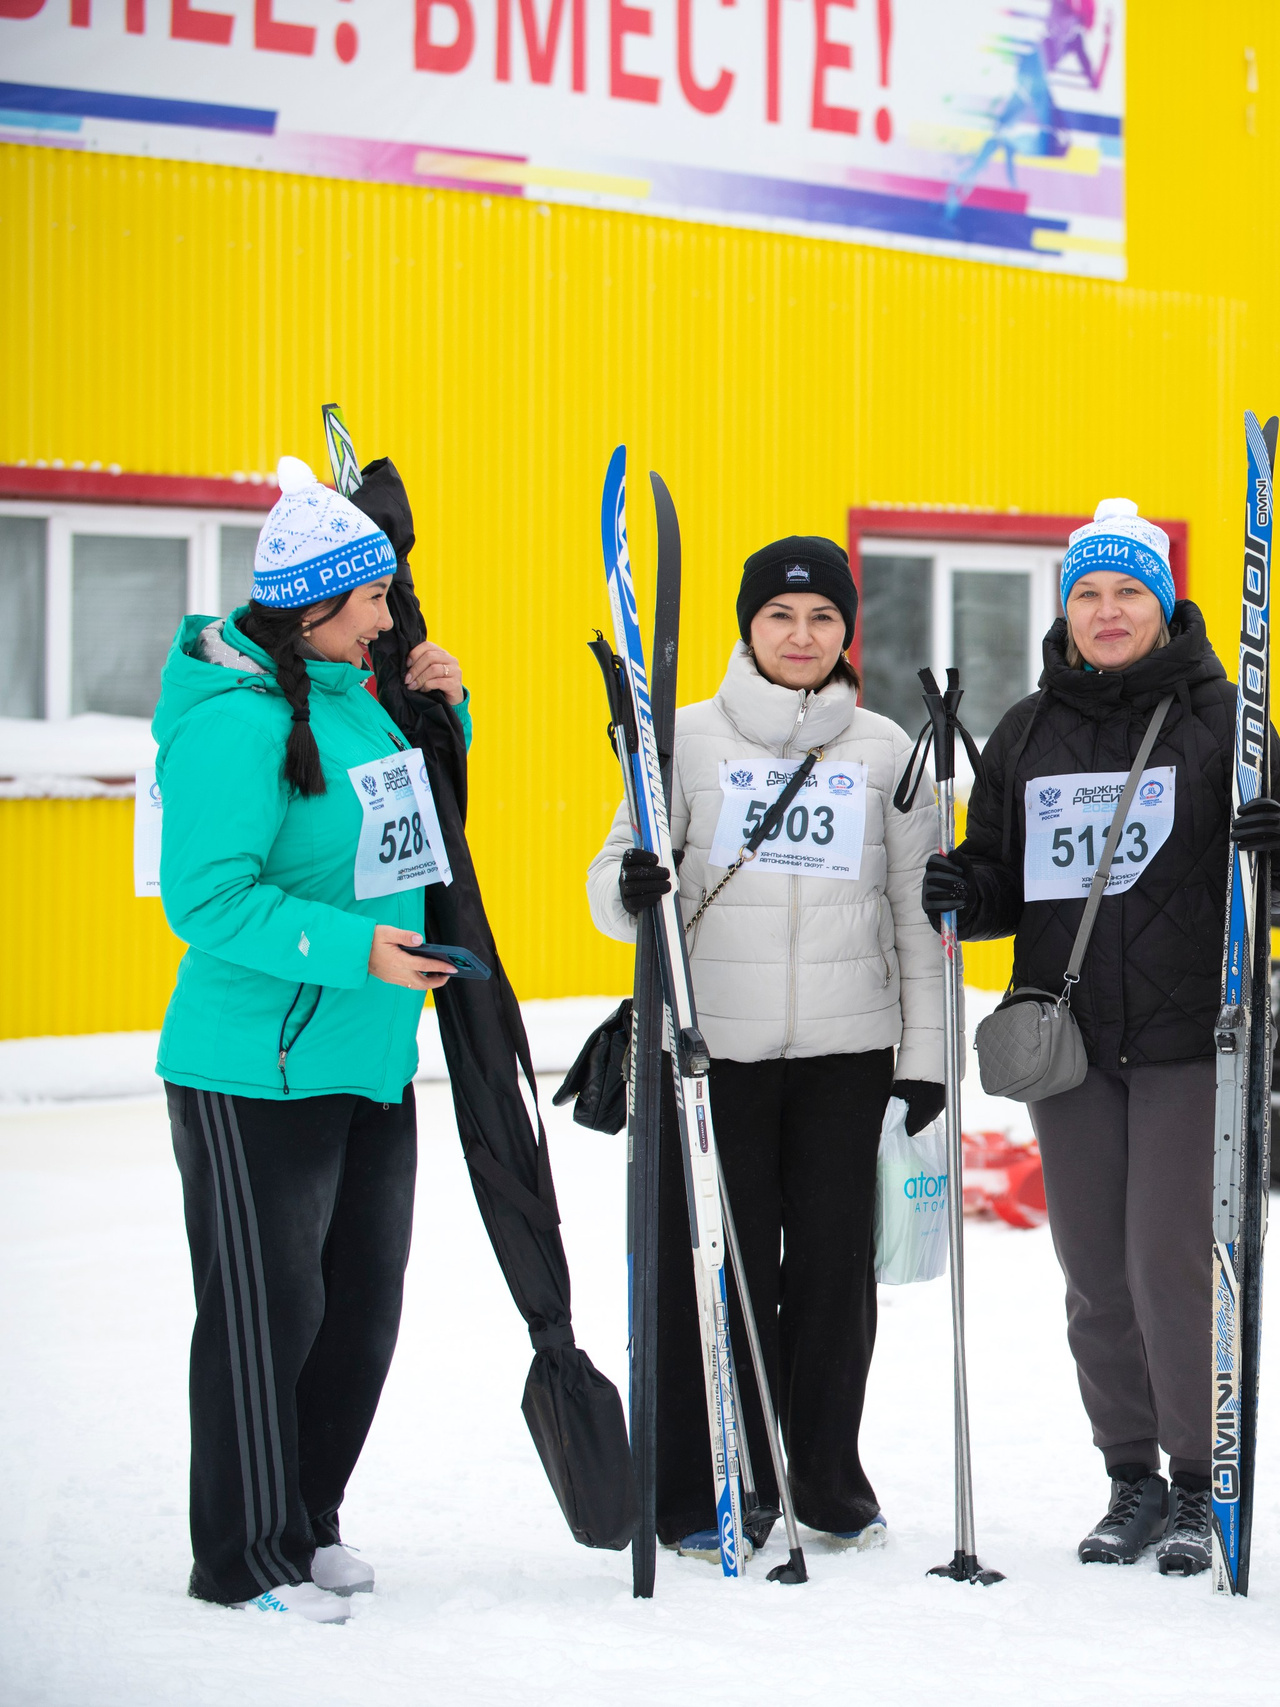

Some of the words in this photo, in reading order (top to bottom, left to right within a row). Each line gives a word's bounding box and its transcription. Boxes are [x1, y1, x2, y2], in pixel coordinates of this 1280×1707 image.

[1256, 478, 1268, 527] OMNI
[250, 576, 310, 602] ЛЫЖНЯ
[318, 542, 396, 586] РОССИИ
[628, 657, 672, 837] MARPETTI
[384, 775, 412, 792] РОССИ
[1072, 793, 1123, 806] РОССИ
[379, 811, 431, 864] 528
[1041, 813, 1061, 821] РОССИИ
[1051, 821, 1149, 868] 5123
[629, 1008, 639, 1117] MARPETTI
[664, 1002, 685, 1111] MARPETTI
[715, 1301, 740, 1478] BOLZANO
[1212, 1372, 1240, 1502] OMNI
[716, 1452, 726, 1483] 180
